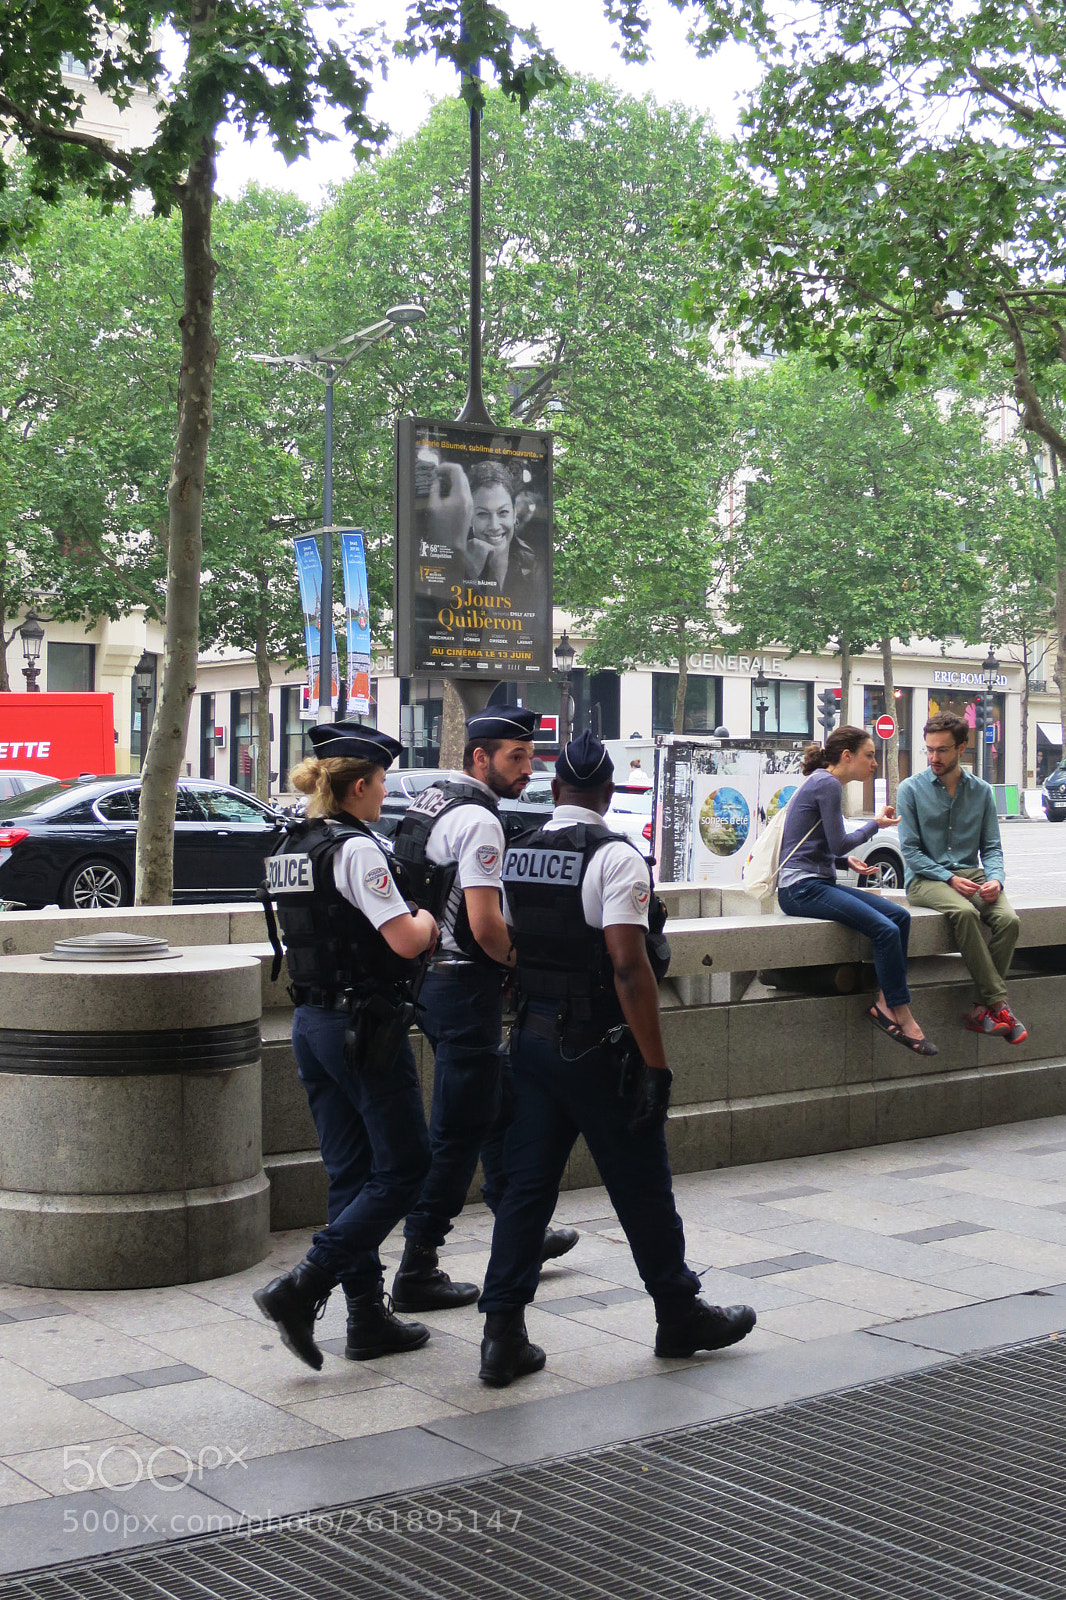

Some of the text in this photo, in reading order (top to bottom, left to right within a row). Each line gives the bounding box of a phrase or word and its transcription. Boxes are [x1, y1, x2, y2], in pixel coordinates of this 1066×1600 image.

[441, 440, 468, 451] Bäumer,
[469, 446, 494, 455] sublime
[495, 448, 502, 456] et
[503, 449, 539, 459] émouvante.
[424, 568, 430, 576] 7
[450, 585, 512, 610] 3 Jours
[438, 607, 523, 632] Quiberon
[431, 648, 444, 656] AU
[446, 649, 483, 657] CINÉMA
[510, 652, 532, 660] JUIN
[934, 670, 1008, 686] ERIC BOMRD
[701, 814, 749, 828] songes d'été
[505, 852, 577, 880] POLICE
